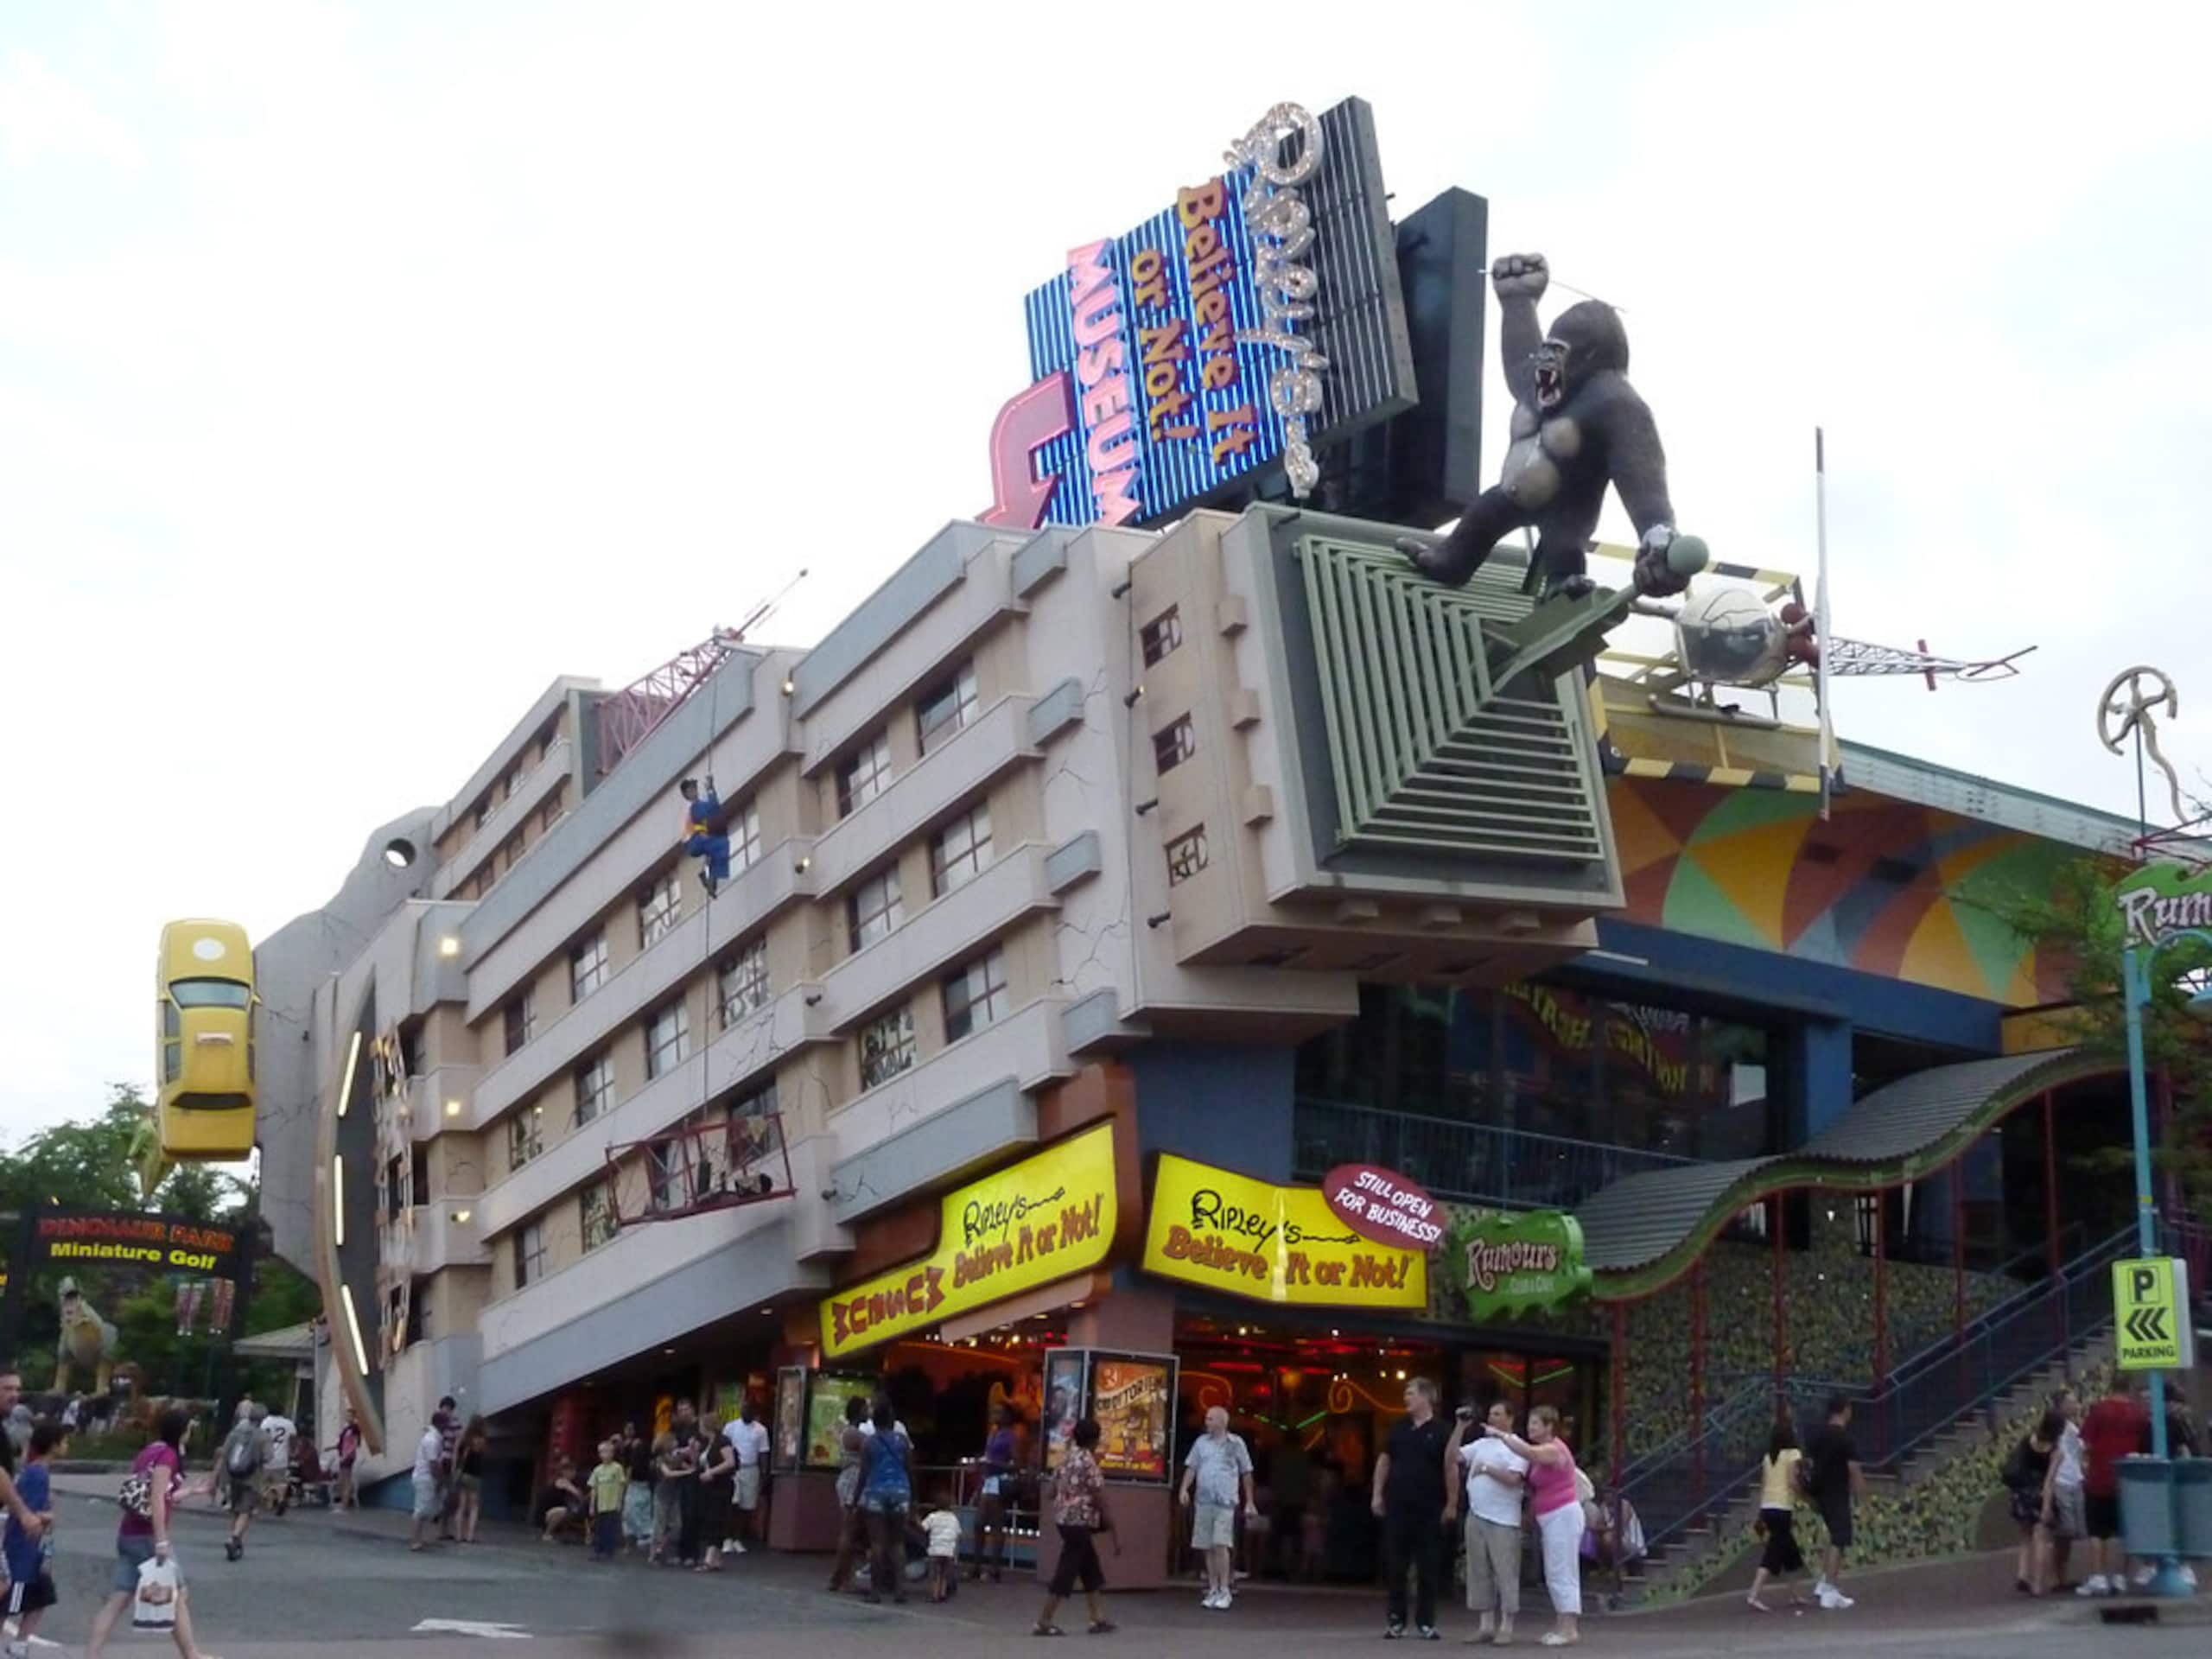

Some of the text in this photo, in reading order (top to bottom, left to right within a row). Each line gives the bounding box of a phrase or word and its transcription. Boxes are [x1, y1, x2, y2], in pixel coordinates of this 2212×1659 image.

[1130, 248, 1200, 442] or Not!
[1177, 176, 1260, 464] Believe It
[1067, 238, 1142, 527] MUSEUM
[1191, 1189, 1361, 1251] Ripley's
[1334, 1187, 1442, 1244] FOR BUSINESS!
[1353, 1170, 1434, 1217] STILL OPEN
[50, 1243, 217, 1270] Miniature Golf
[952, 1192, 1103, 1288] Believe It or Not!
[1162, 1224, 1409, 1289] Believe It or Not!
[1466, 1236, 1557, 1292] Rumours
[2133, 1269, 2154, 1301] P
[2121, 1344, 2175, 1359] PARKING
